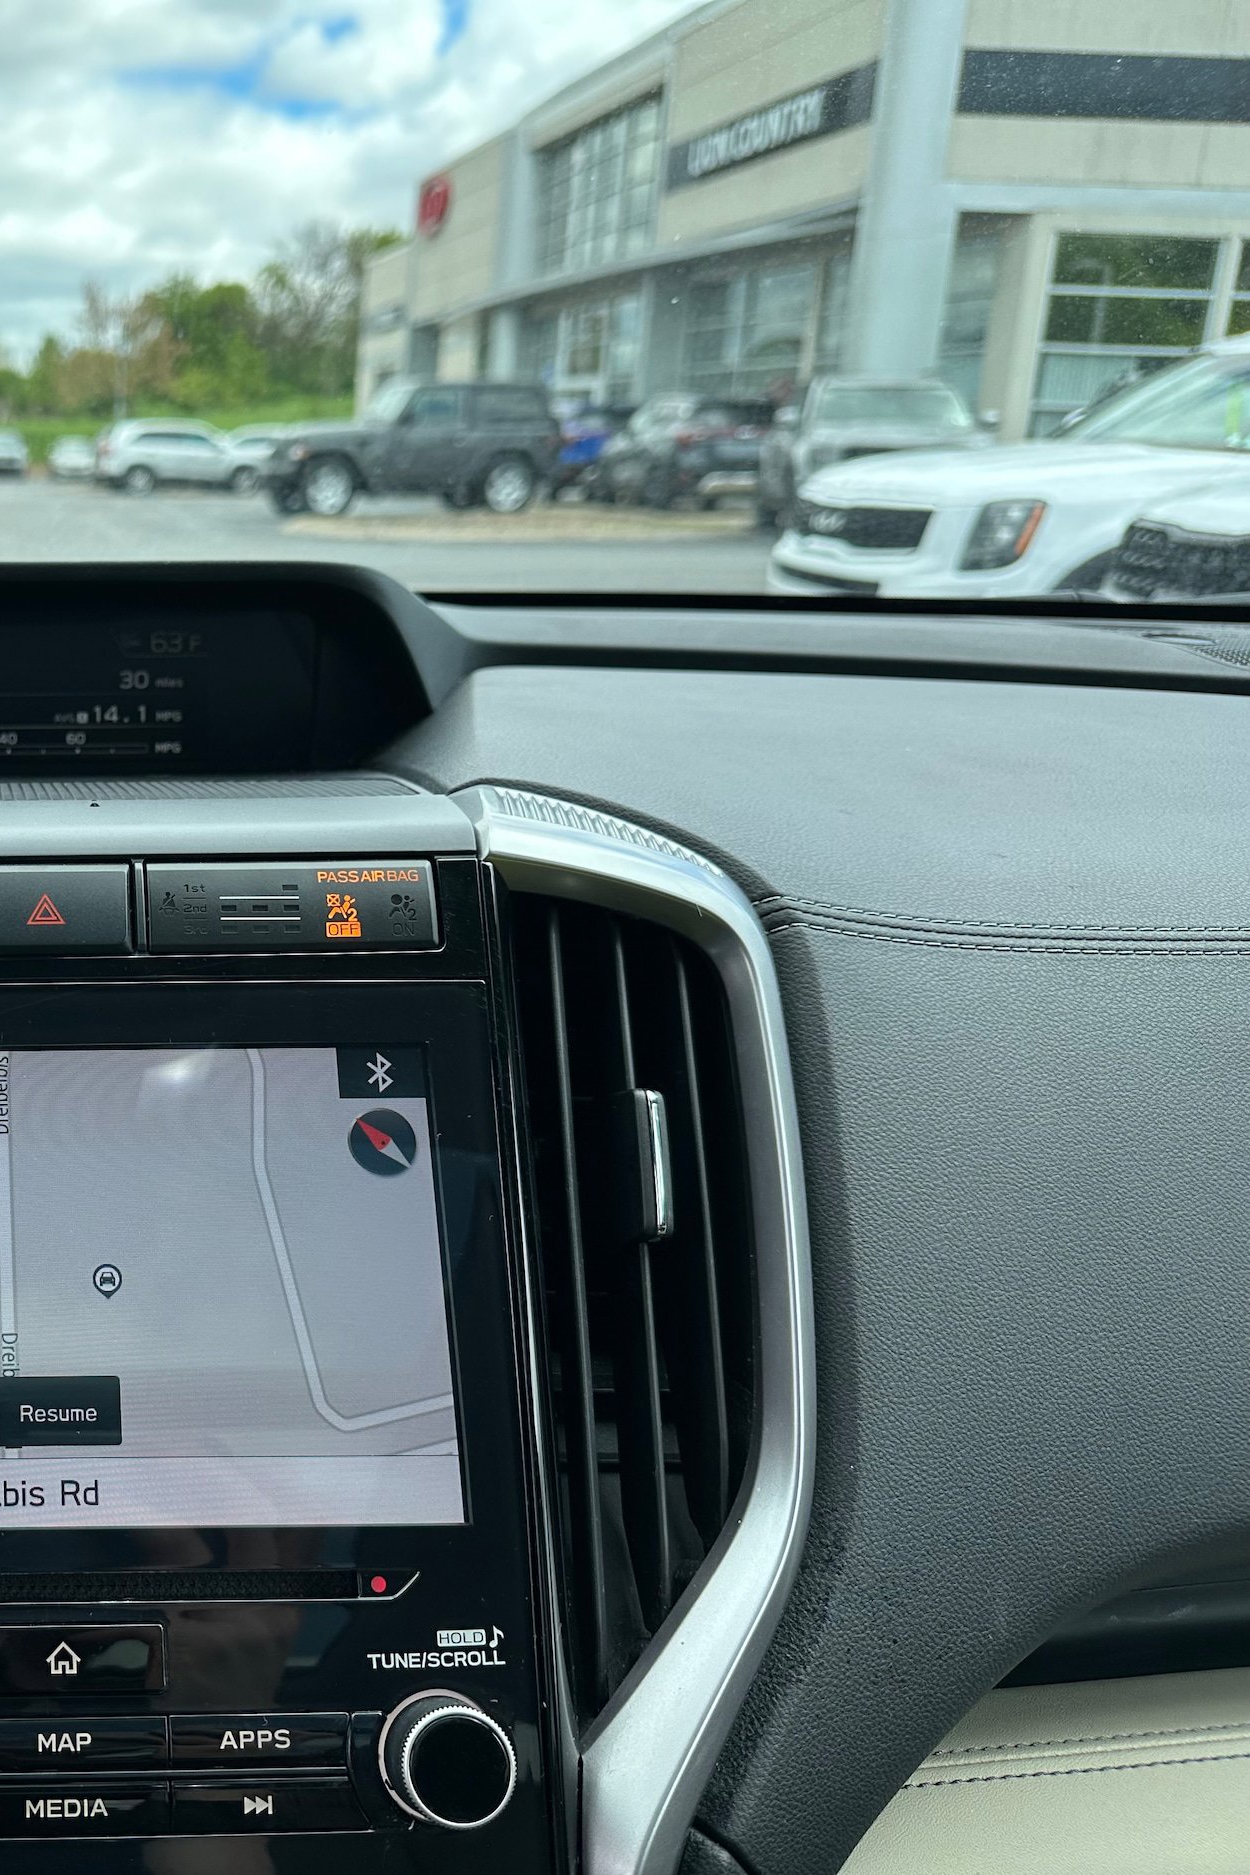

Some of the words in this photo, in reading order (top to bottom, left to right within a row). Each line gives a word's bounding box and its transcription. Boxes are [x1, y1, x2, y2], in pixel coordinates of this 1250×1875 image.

[119, 669, 150, 690] 30
[92, 704, 147, 724] 14.1
[183, 883, 205, 893] 1st
[183, 903, 207, 913] 2nd
[329, 923, 358, 936] OFF
[20, 1404, 98, 1422] Resume
[61, 1479, 100, 1506] Rd
[439, 1632, 484, 1644] HOLD
[367, 1650, 506, 1669] TUNE/SCROLL
[37, 1733, 92, 1753] MAP
[219, 1730, 291, 1750] APPS
[25, 1799, 108, 1819] MEDIA
